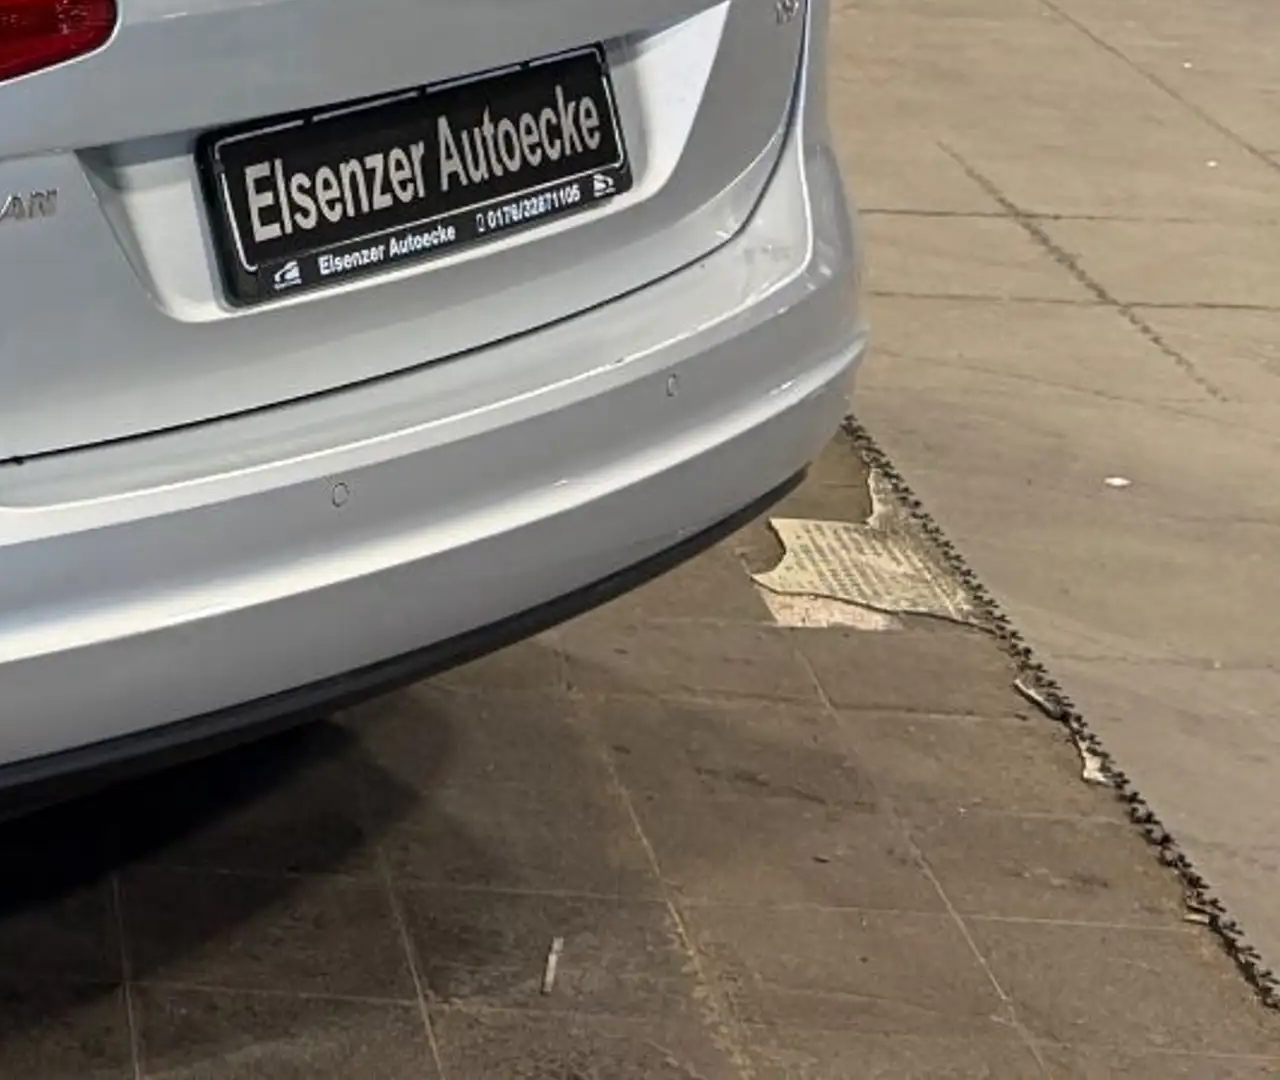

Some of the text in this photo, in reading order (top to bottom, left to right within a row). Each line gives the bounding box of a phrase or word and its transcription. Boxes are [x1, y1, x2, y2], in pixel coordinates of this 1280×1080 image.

[244, 84, 601, 243] Elsenzer Autoecke
[389, 224, 457, 257] Autoecke
